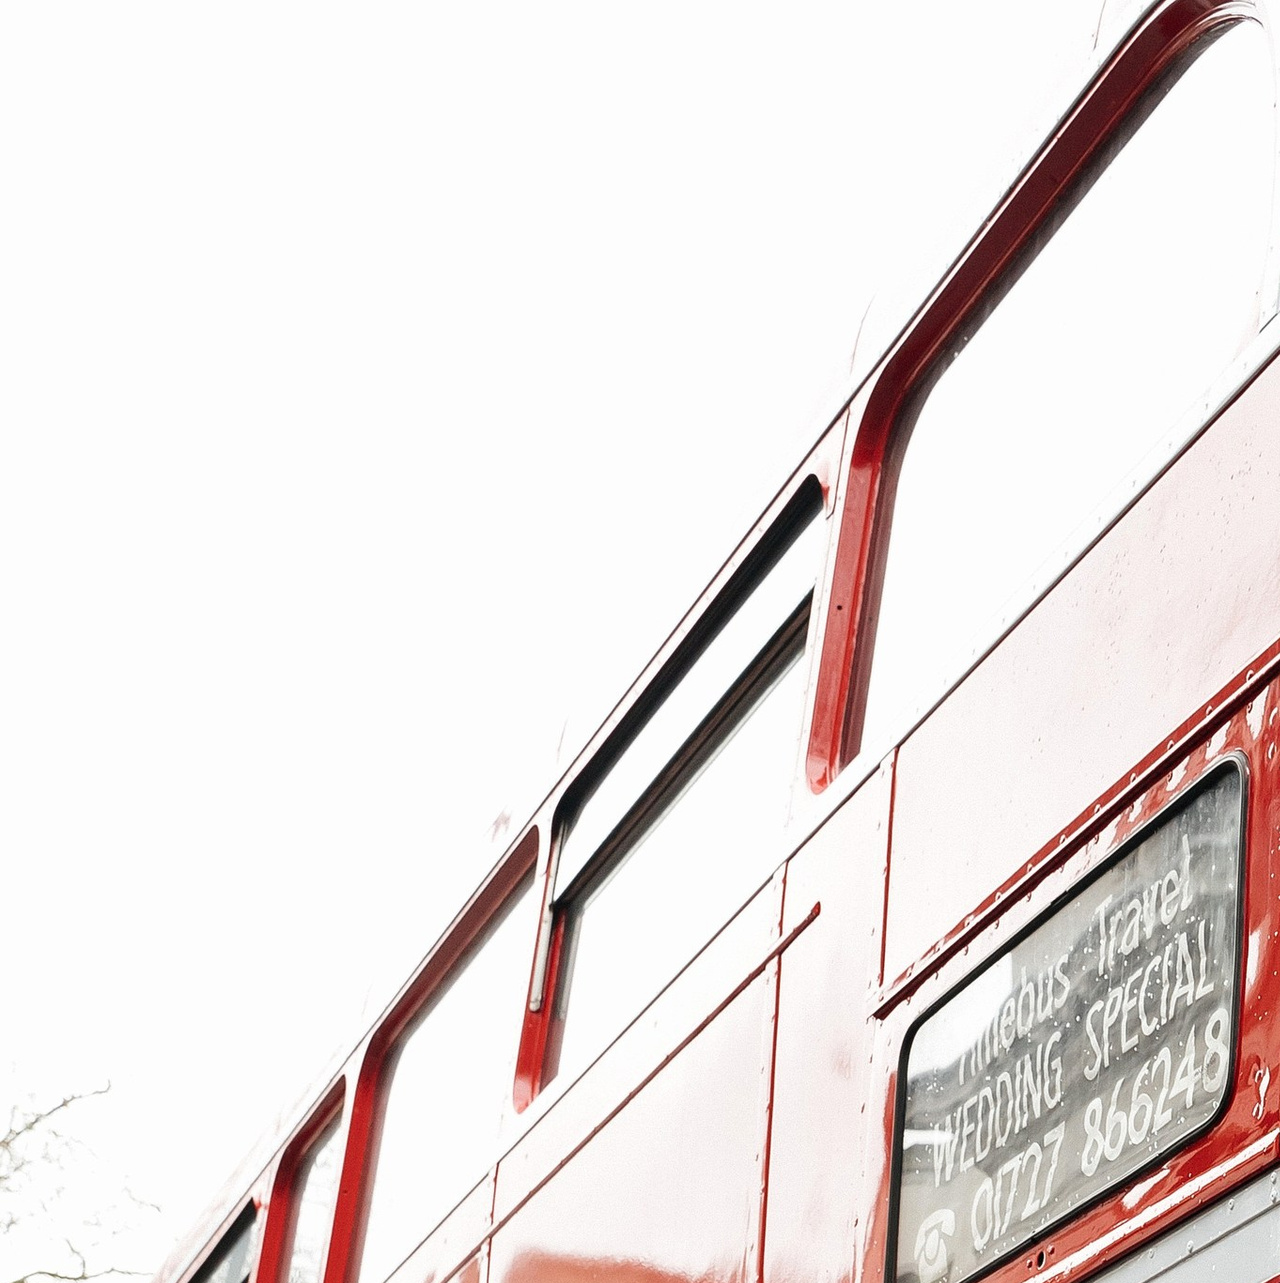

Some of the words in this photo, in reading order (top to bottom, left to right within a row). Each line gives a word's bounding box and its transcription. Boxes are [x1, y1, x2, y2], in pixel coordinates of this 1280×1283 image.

[1091, 833, 1194, 977] Travel
[933, 1031, 1063, 1188] WEDDING
[1084, 920, 1214, 1081] SPECIAL
[971, 1121, 1066, 1251] 01727
[1081, 1008, 1229, 1176] 866248
